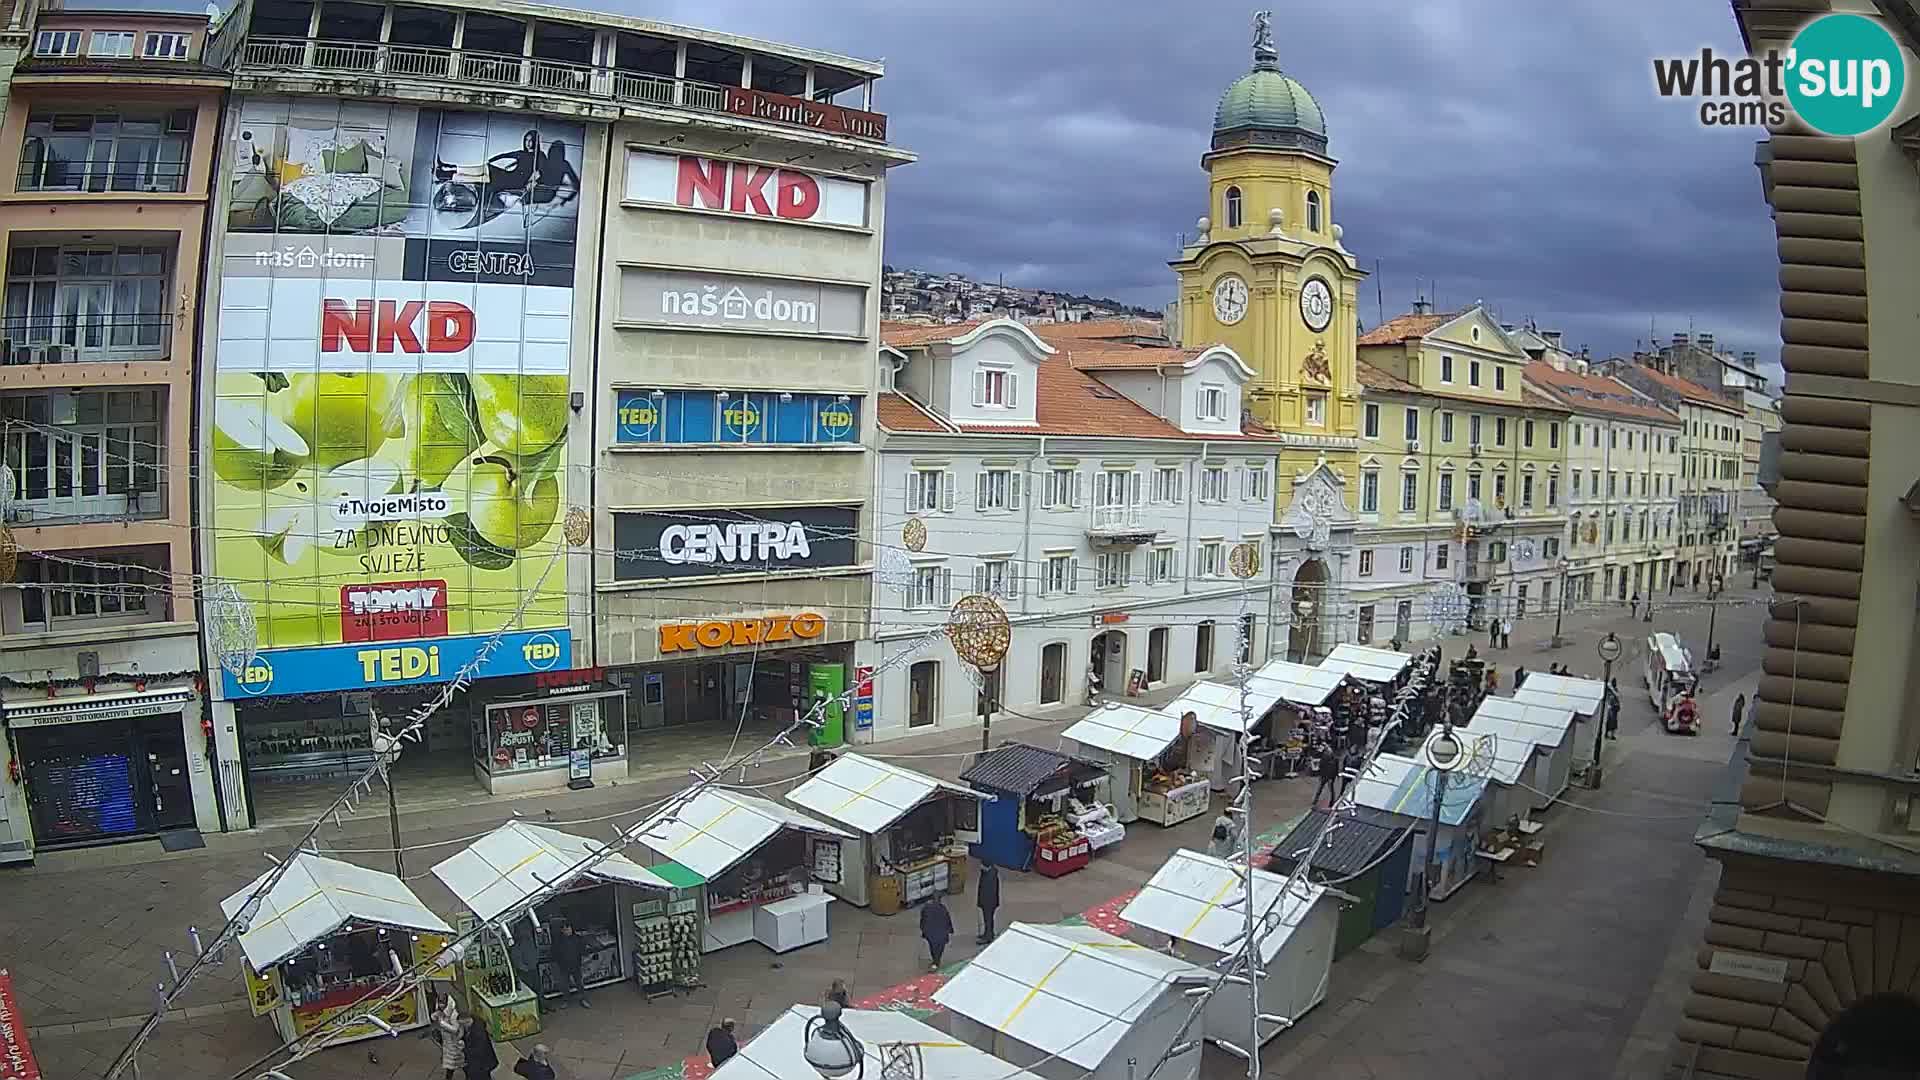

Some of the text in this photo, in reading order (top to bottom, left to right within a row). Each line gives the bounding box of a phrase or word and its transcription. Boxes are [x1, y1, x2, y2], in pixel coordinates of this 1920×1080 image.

[723, 88, 746, 112] Le
[675, 156, 821, 220] NKD
[255, 246, 366, 269] naš dom
[448, 250, 535, 276] CENTRA
[662, 284, 816, 323] naš dom
[320, 298, 477, 354] NKD
[618, 408, 658, 425] TEDi
[723, 409, 760, 425] TEDi
[820, 411, 853, 426] TEDi
[339, 497, 446, 517] #TvojeMisto
[334, 525, 450, 549] ZA DNEVNO
[659, 521, 811, 565] CENTRA
[359, 547, 426, 575] SVJEŽE
[348, 586, 439, 615] TOMMY
[659, 612, 826, 653] KORZO
[358, 645, 440, 682] TEDi
[522, 643, 560, 661] TEDi
